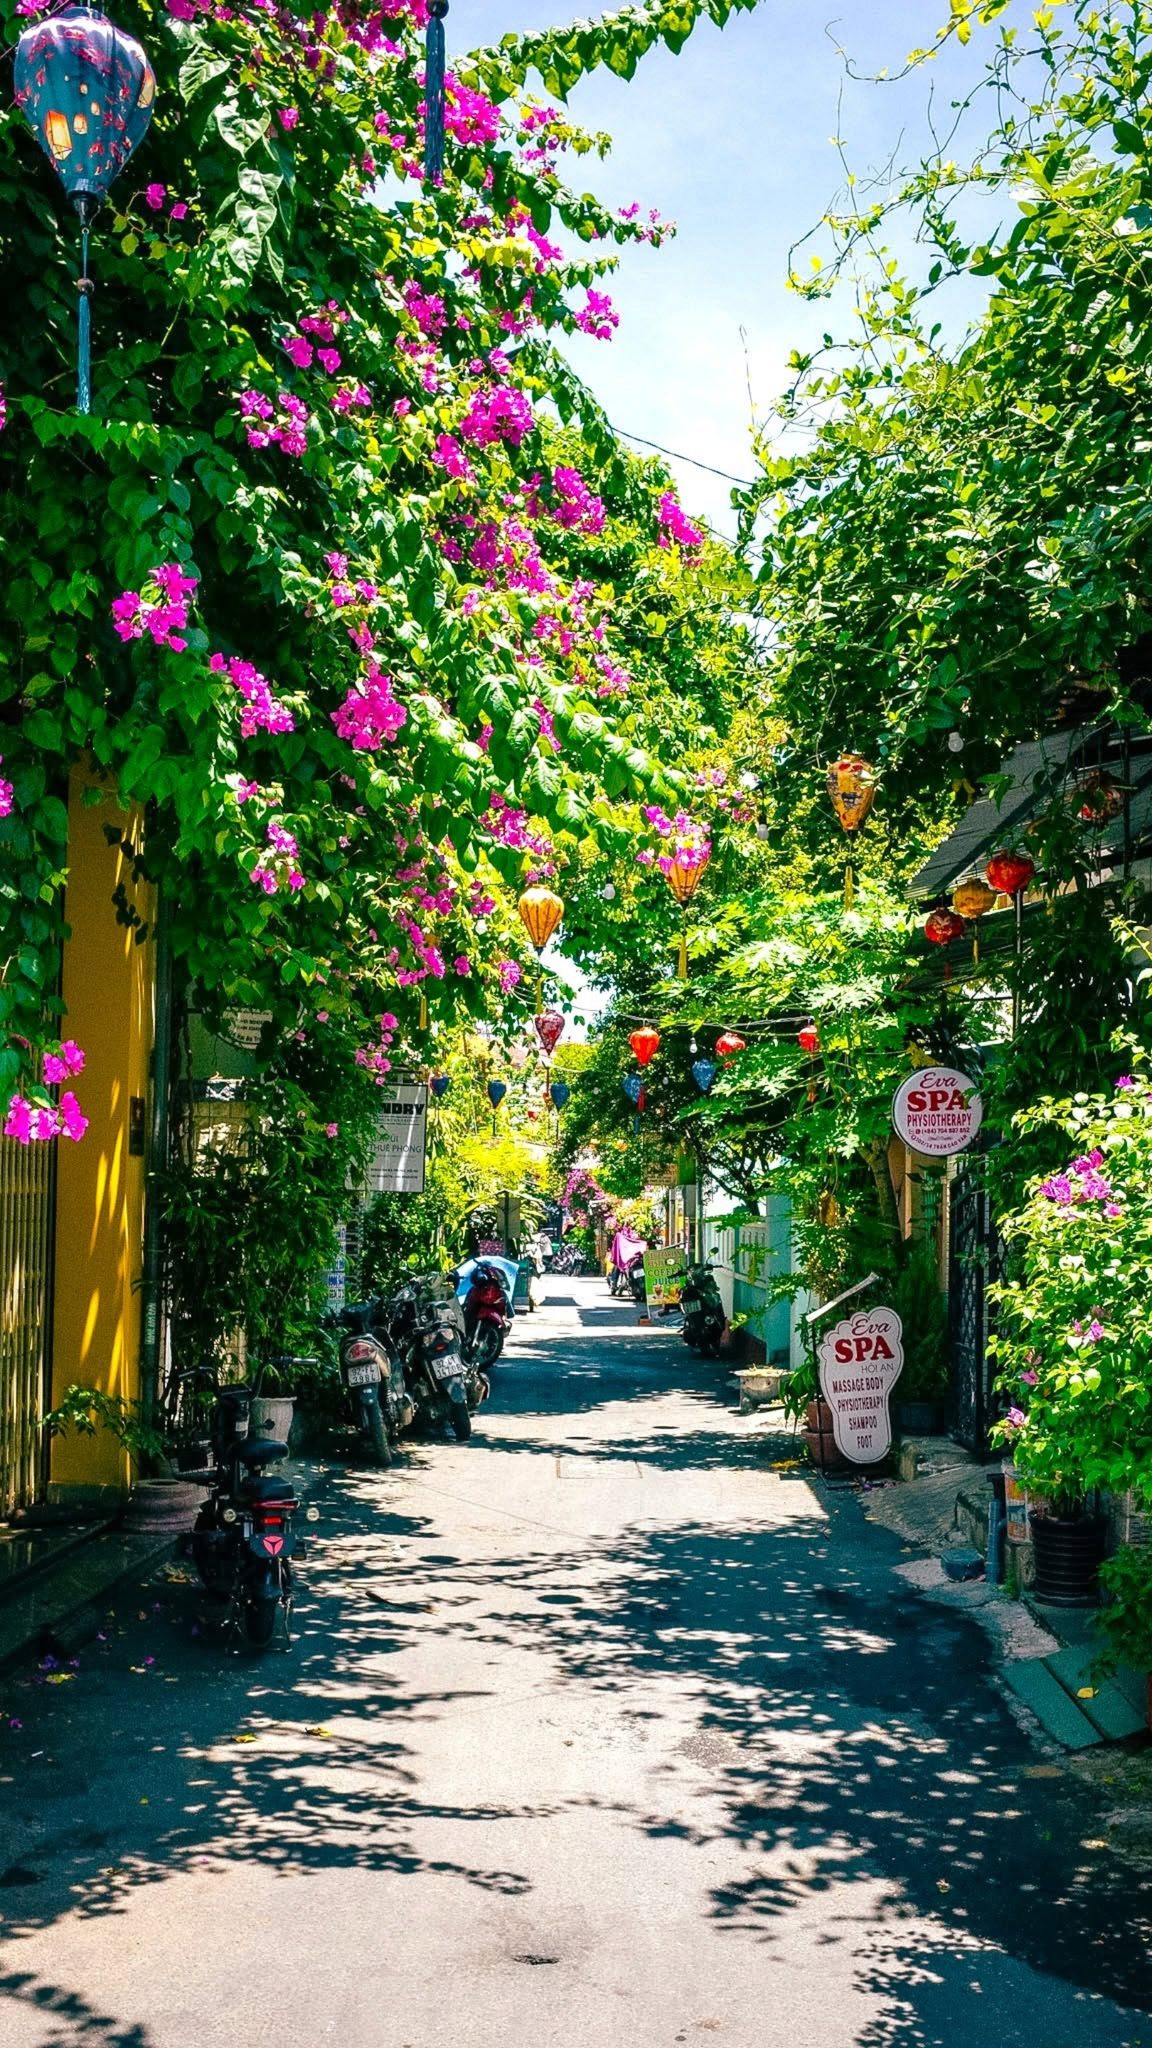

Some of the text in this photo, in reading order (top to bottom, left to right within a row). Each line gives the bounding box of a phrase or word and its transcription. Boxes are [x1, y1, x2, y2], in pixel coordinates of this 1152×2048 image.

[920, 1072, 958, 1088] Eva
[907, 1089, 971, 1112] SPA
[381, 1103, 425, 1115] NDRY
[907, 1113, 971, 1127] PHYSIOTHERAPY
[852, 1319, 891, 1336] Eva
[835, 1335, 895, 1363] SPA
[880, 1362, 894, 1372] AN
[832, 1376, 884, 1394] MASSAGE BODY
[838, 1396, 884, 1412] PHYSIOTHERAPY
[849, 1416, 878, 1430] SHAMPOO
[857, 1435, 873, 1449] FOOT
